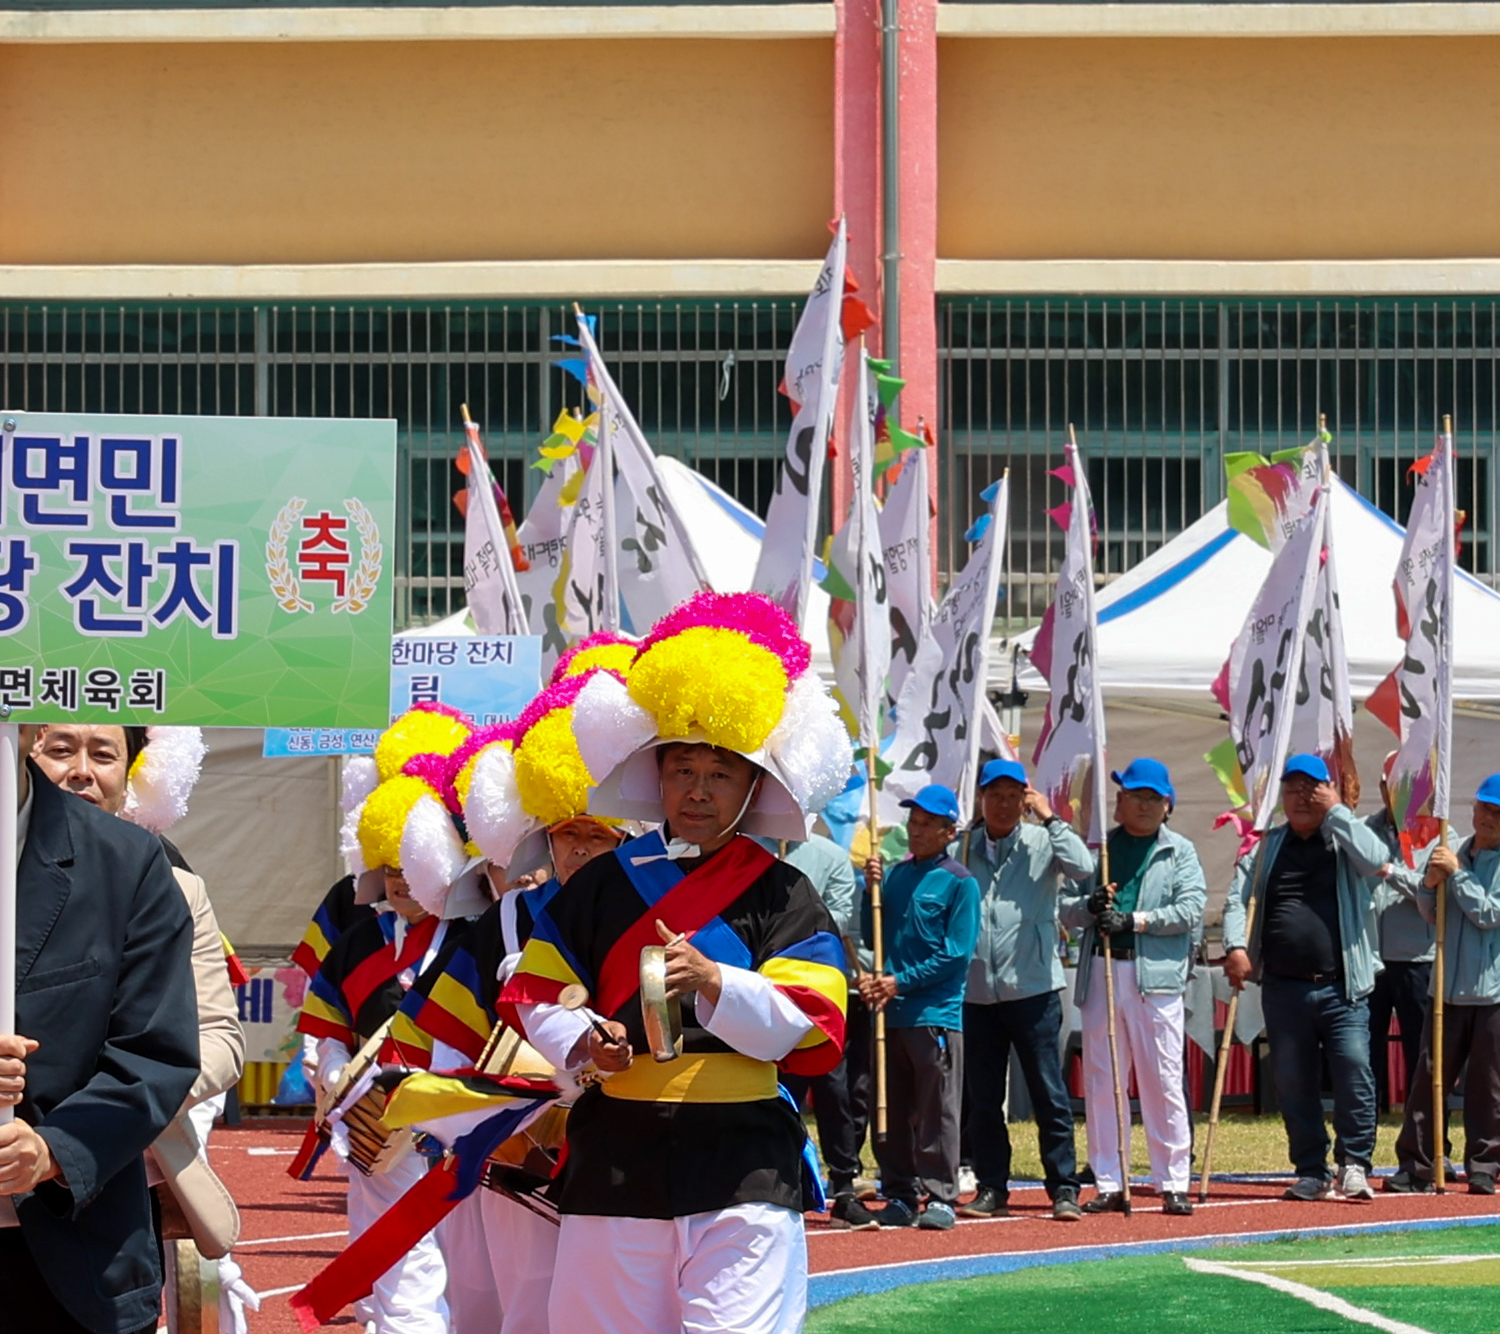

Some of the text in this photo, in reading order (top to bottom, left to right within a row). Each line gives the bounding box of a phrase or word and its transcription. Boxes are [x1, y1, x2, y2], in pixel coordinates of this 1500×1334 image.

[65, 540, 235, 637] 잔치
[299, 511, 351, 597] 축
[391, 639, 513, 666] 한마당 잔치
